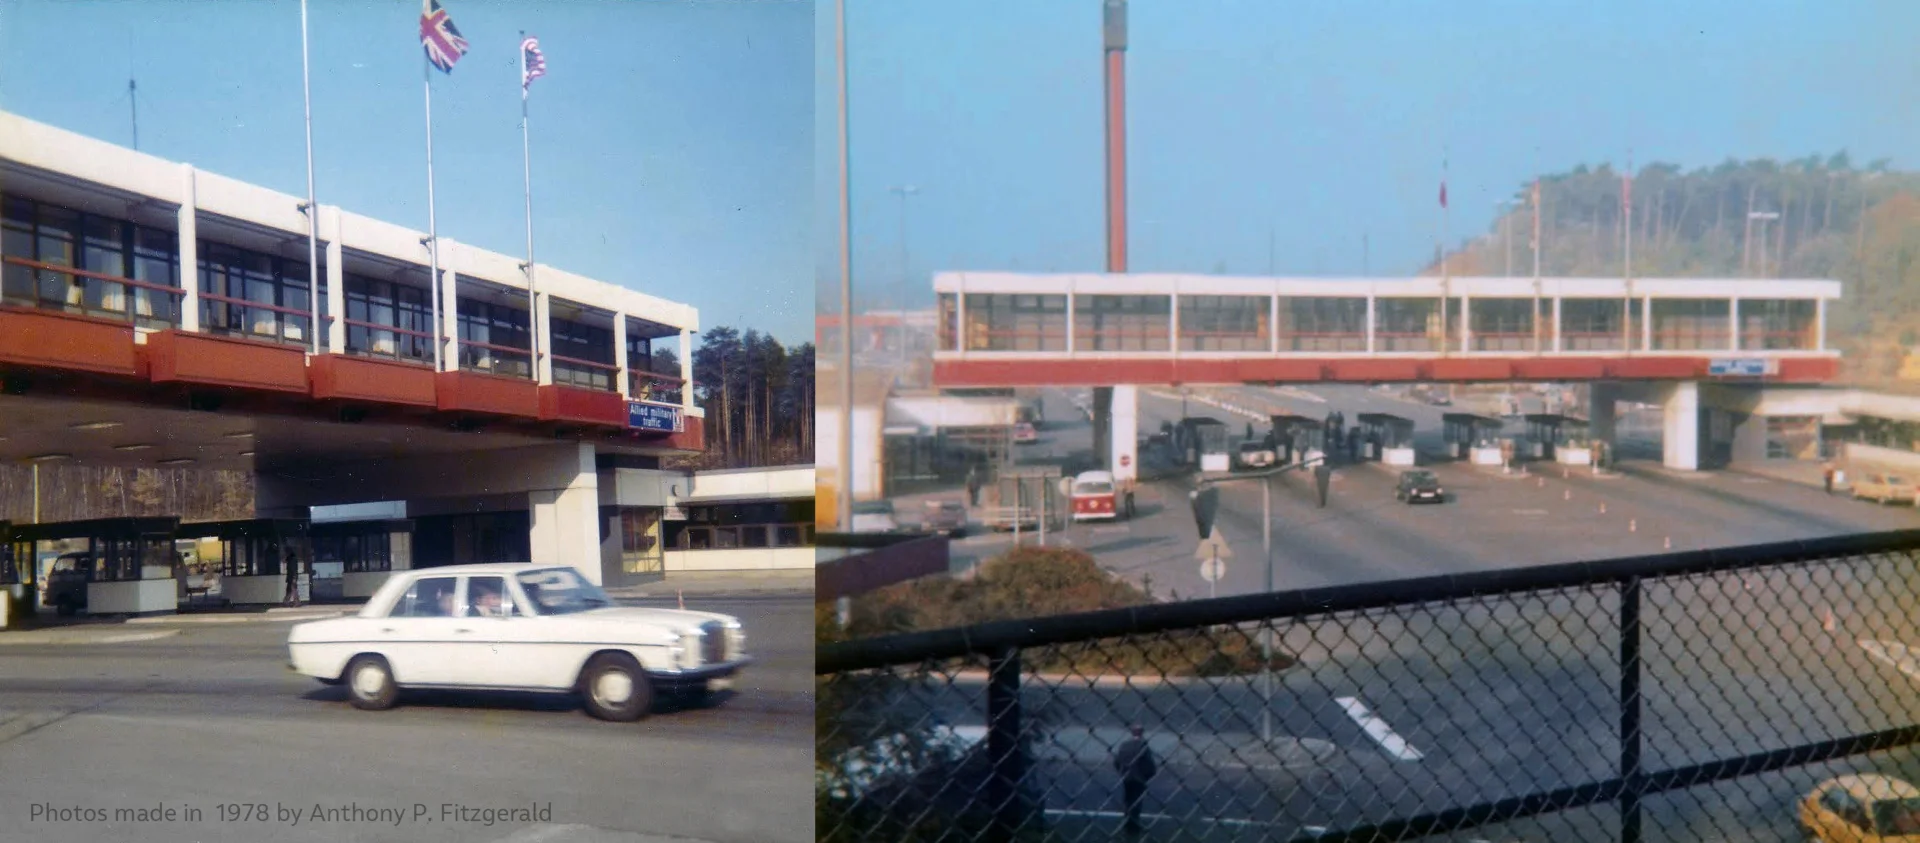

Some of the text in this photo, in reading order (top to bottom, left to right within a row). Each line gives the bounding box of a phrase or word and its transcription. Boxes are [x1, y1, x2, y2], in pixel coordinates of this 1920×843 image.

[630, 404, 672, 420] Allied military
[643, 417, 661, 427] traffic
